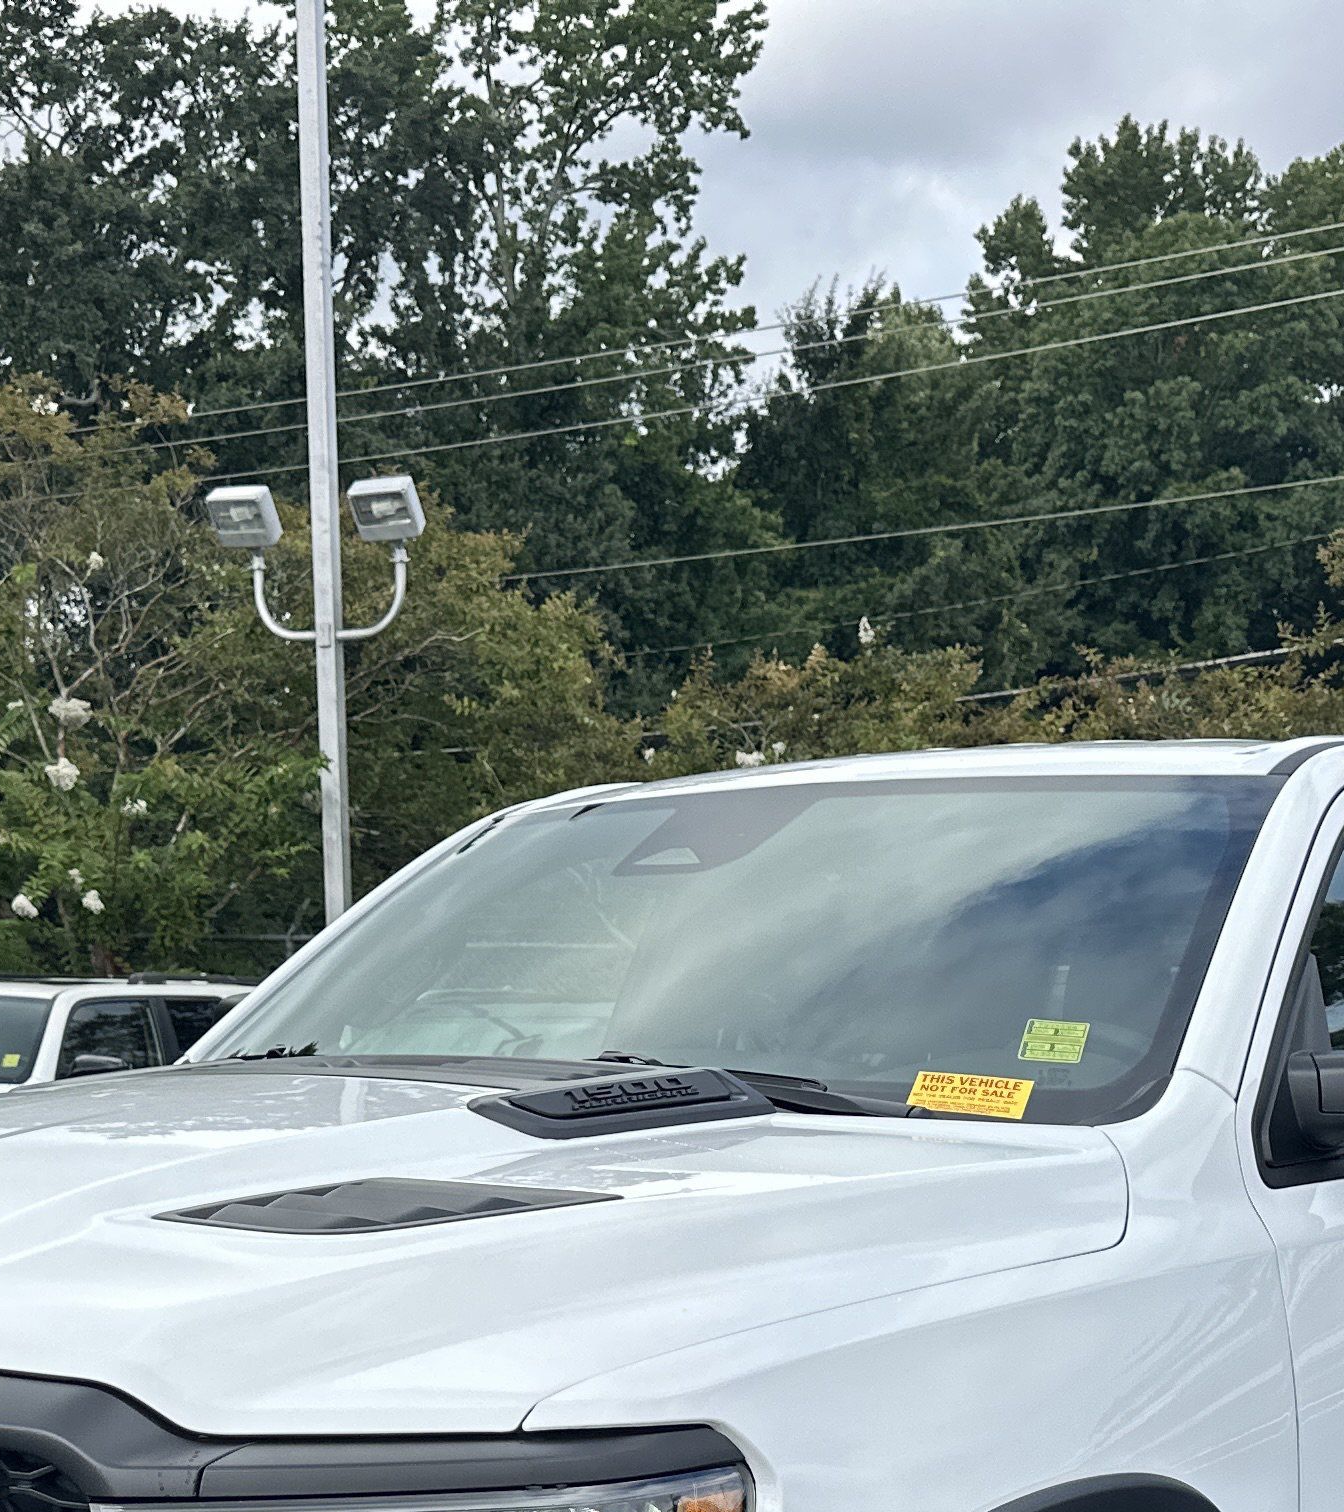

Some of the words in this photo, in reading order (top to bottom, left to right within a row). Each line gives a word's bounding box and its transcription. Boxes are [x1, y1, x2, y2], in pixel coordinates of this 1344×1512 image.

[564, 1077, 693, 1104] 1500
[920, 1083, 948, 1093] NOT
[950, 1086, 977, 1096] FOR
[981, 1089, 1015, 1099] SALE
[921, 1073, 955, 1085] THIS
[959, 1076, 1023, 1091] VEHICLE
